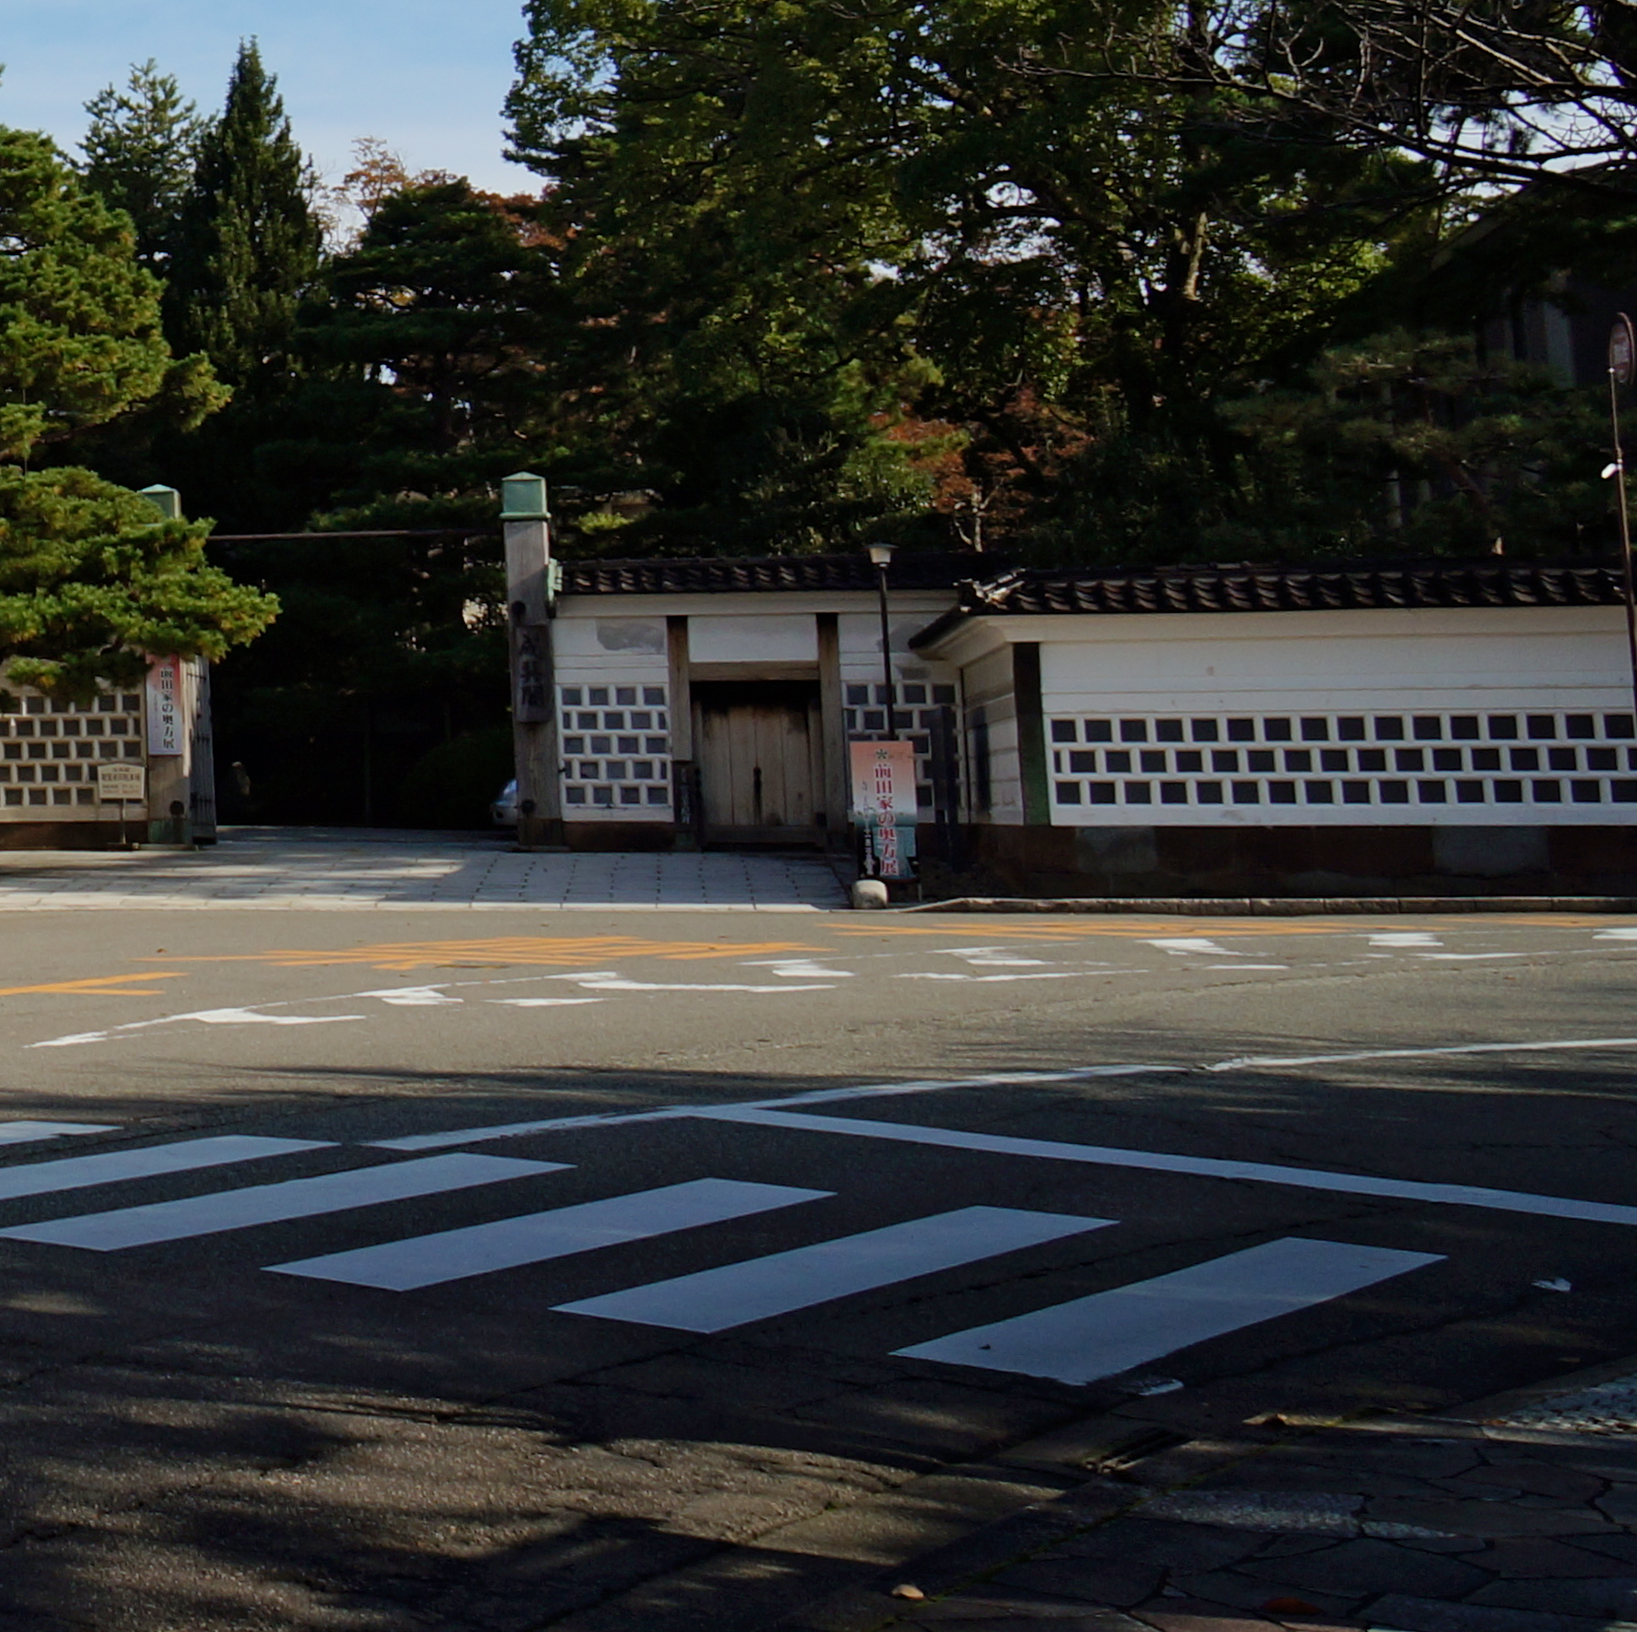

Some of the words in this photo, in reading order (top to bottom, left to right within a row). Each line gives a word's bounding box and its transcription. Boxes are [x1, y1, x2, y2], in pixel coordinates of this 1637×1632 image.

[160, 666, 175, 749] 前田家の奥方展
[874, 763, 898, 875] 前田家の奥方展
